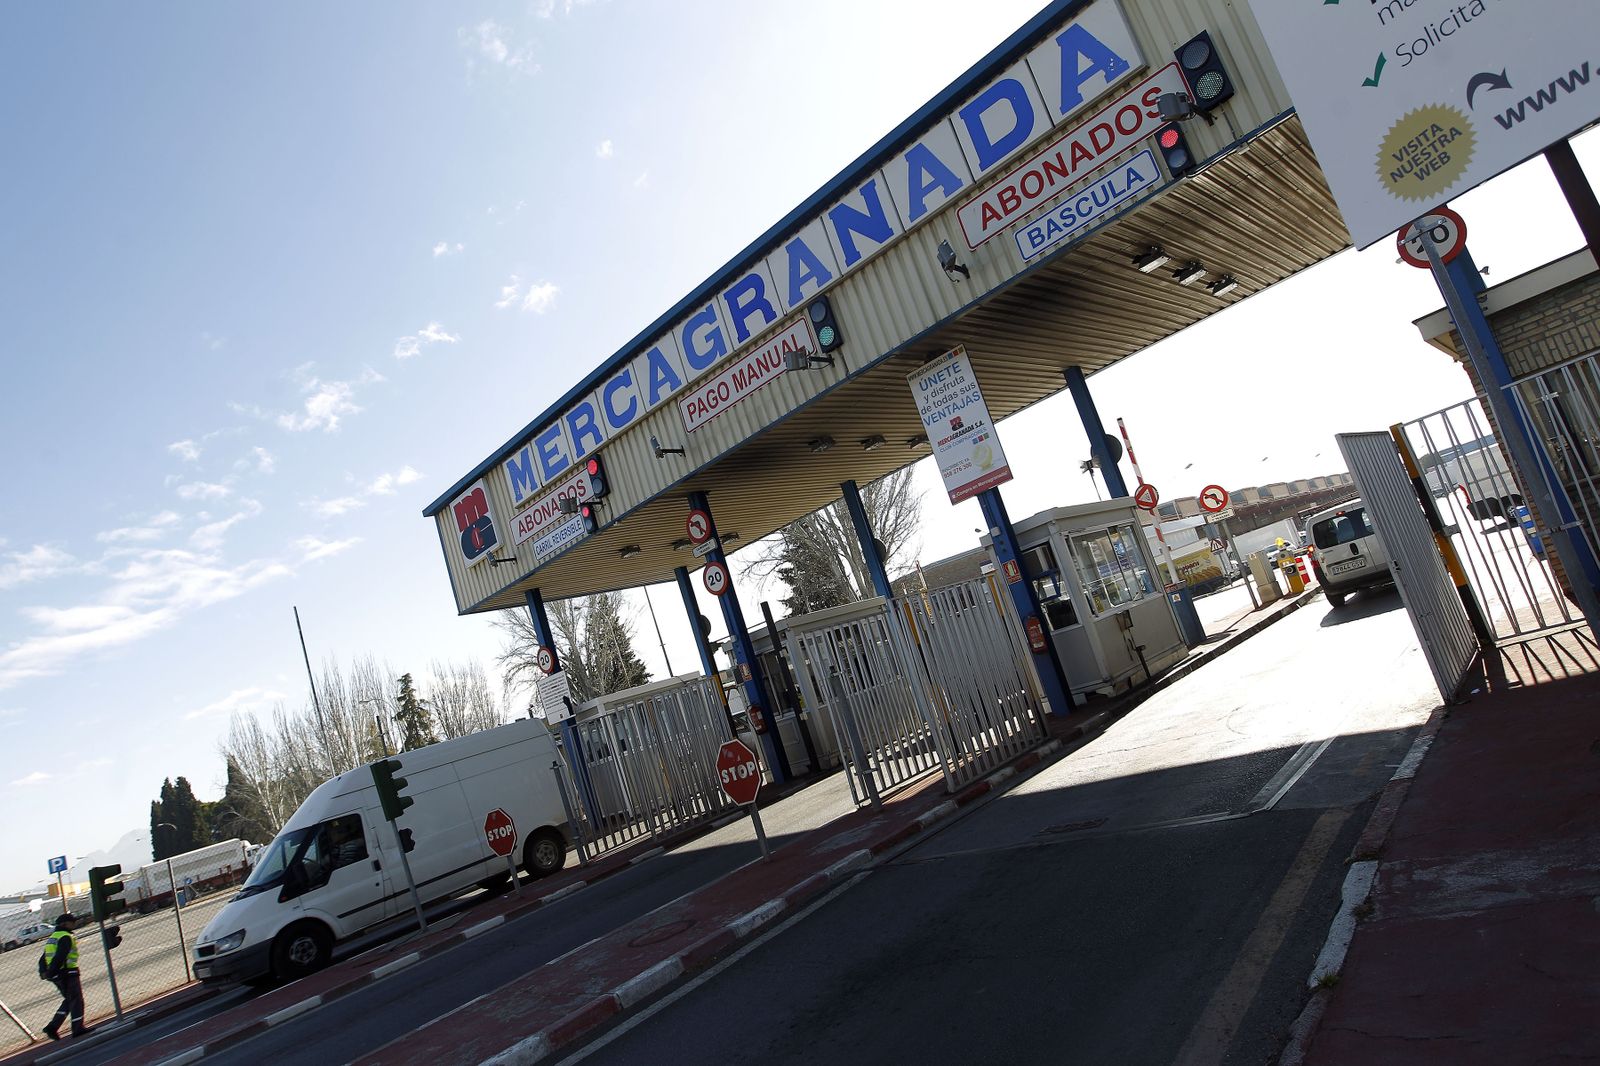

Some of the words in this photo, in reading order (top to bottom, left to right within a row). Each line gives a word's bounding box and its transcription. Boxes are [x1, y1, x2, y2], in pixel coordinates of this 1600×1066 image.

[1395, 0, 1486, 67] Solicita
[1390, 127, 1463, 183] NUESTRA
[1392, 124, 1444, 162] VISITA
[982, 86, 1162, 231] ABONADOS
[1413, 151, 1451, 181] WEB
[1026, 166, 1145, 249] BASCULA
[1411, 224, 1450, 254] 0
[506, 23, 1130, 503] MERCAGRANADA
[919, 361, 962, 391] ÚNETE
[924, 394, 929, 404] y
[931, 376, 965, 398] disfruta
[687, 381, 730, 423] PAGO
[921, 405, 932, 415] de
[933, 391, 959, 408] todas
[960, 382, 976, 395] sus
[923, 391, 981, 426] VENTAJAS
[953, 466, 963, 474] 276
[552, 520, 582, 546] REVERSIBLE
[708, 571, 722, 586] 20
[540, 654, 549, 666] 20
[721, 761, 756, 784] STOP
[488, 824, 513, 841] STOP
[51, 857, 63, 871] P
